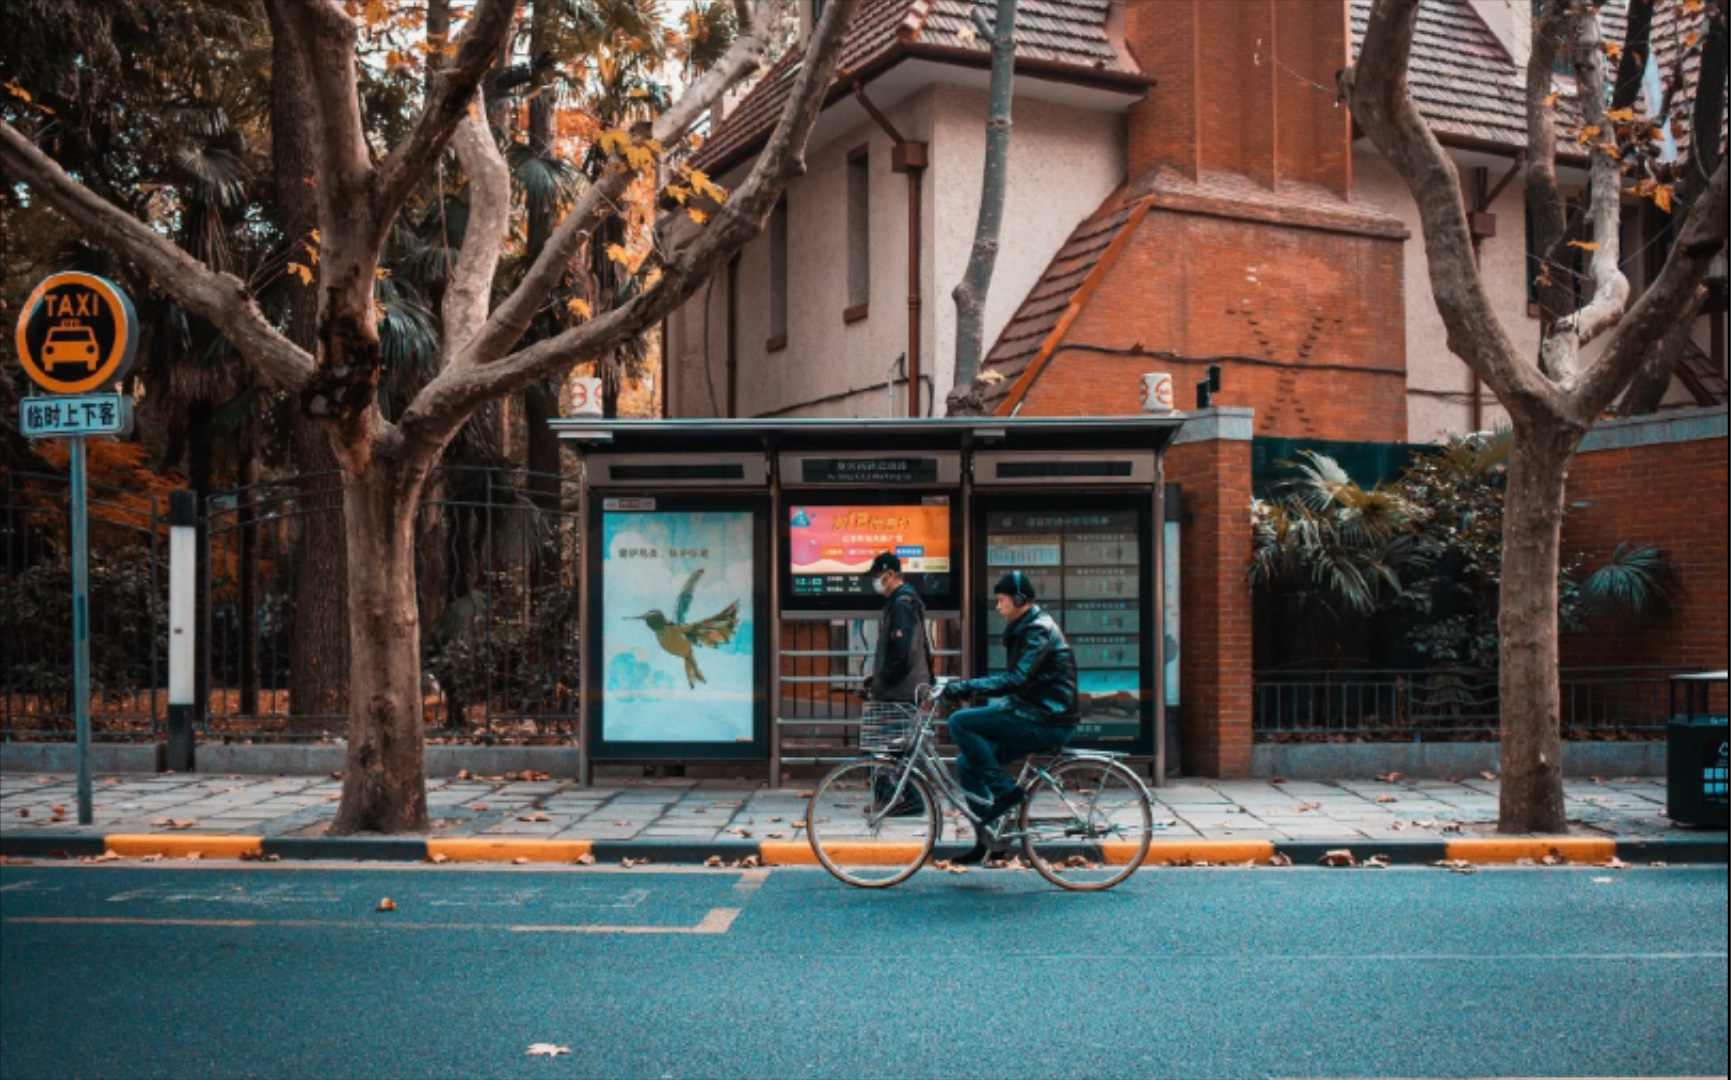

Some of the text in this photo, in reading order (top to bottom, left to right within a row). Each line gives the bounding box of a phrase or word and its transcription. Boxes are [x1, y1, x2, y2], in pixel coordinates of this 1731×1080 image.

[44, 293, 99, 317] TAXI
[27, 402, 116, 428] 临时上下客
